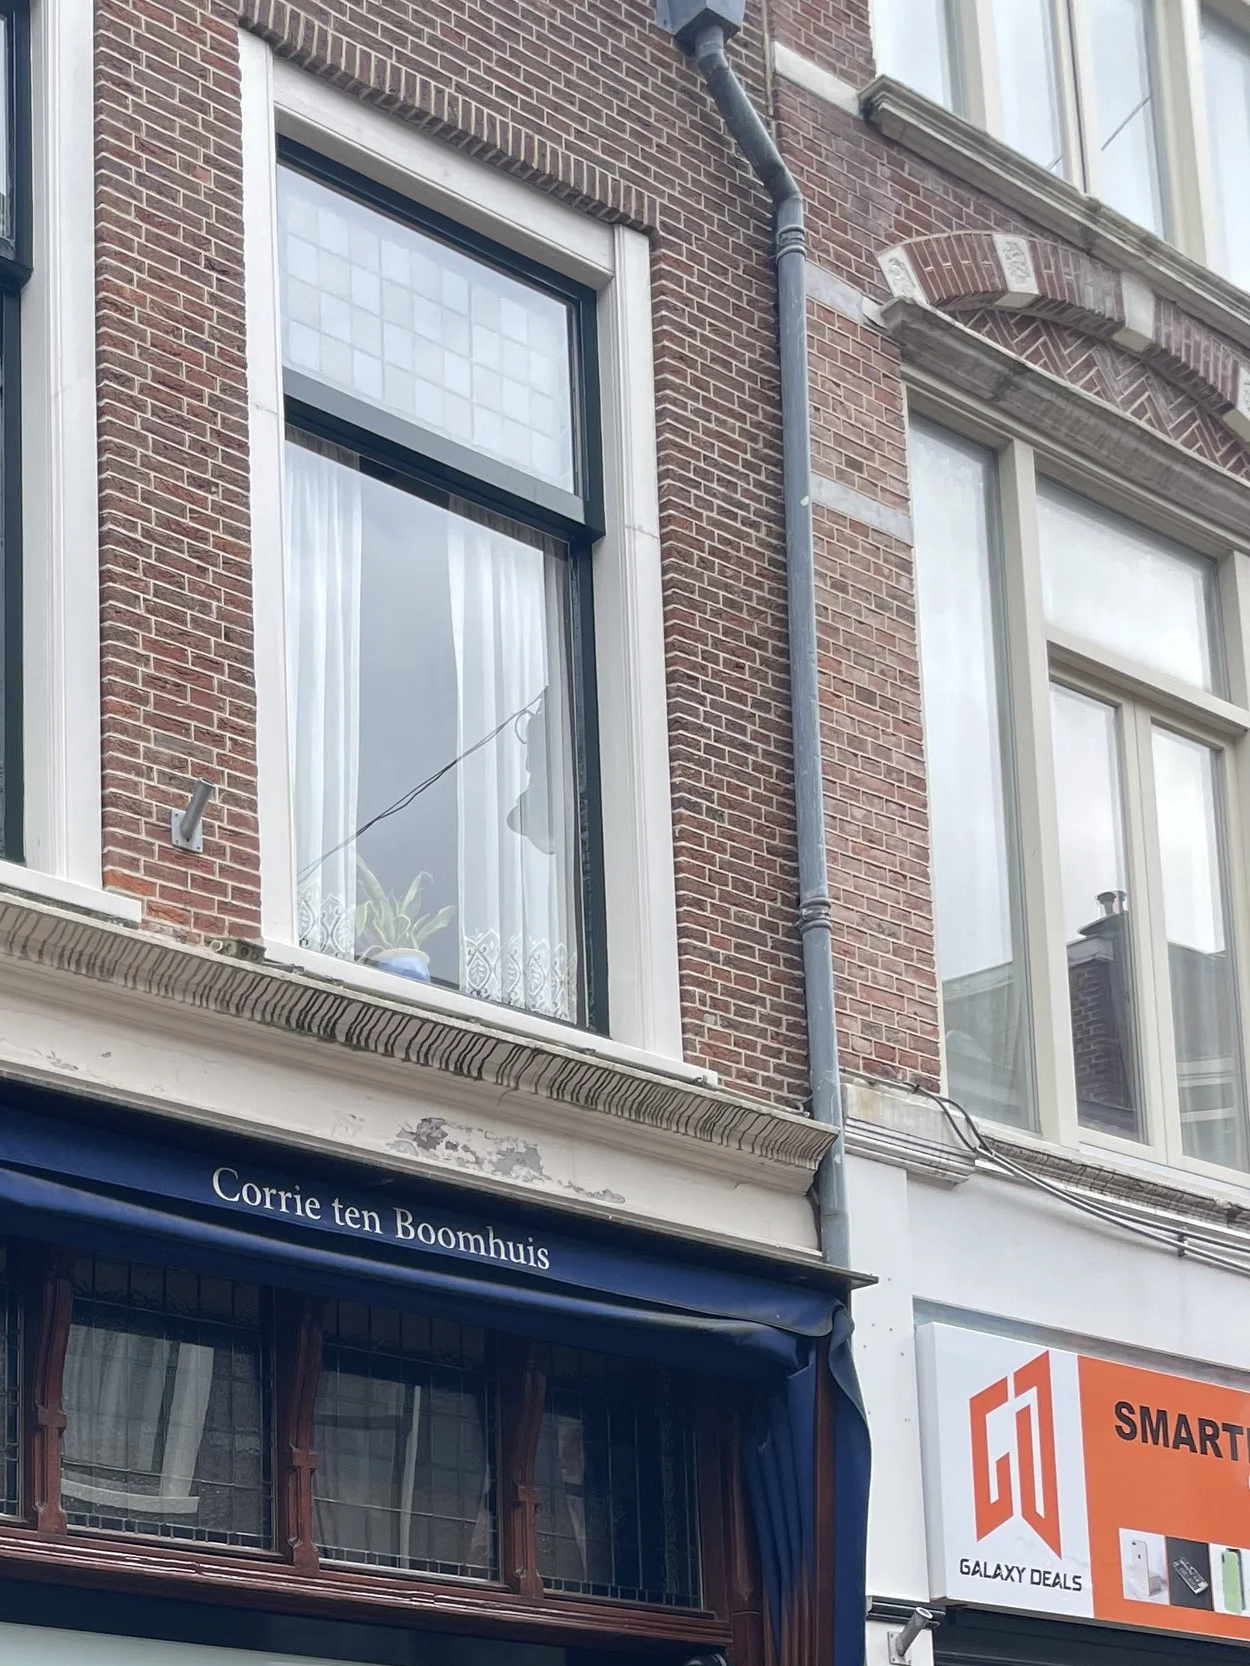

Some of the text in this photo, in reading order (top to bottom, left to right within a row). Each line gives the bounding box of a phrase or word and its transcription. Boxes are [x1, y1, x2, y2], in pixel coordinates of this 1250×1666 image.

[212, 1166, 550, 1271] Corrie ten Boomhuis
[1114, 1400, 1250, 1464] SMART
[959, 1558, 1083, 1592] GALAXY DEALS
